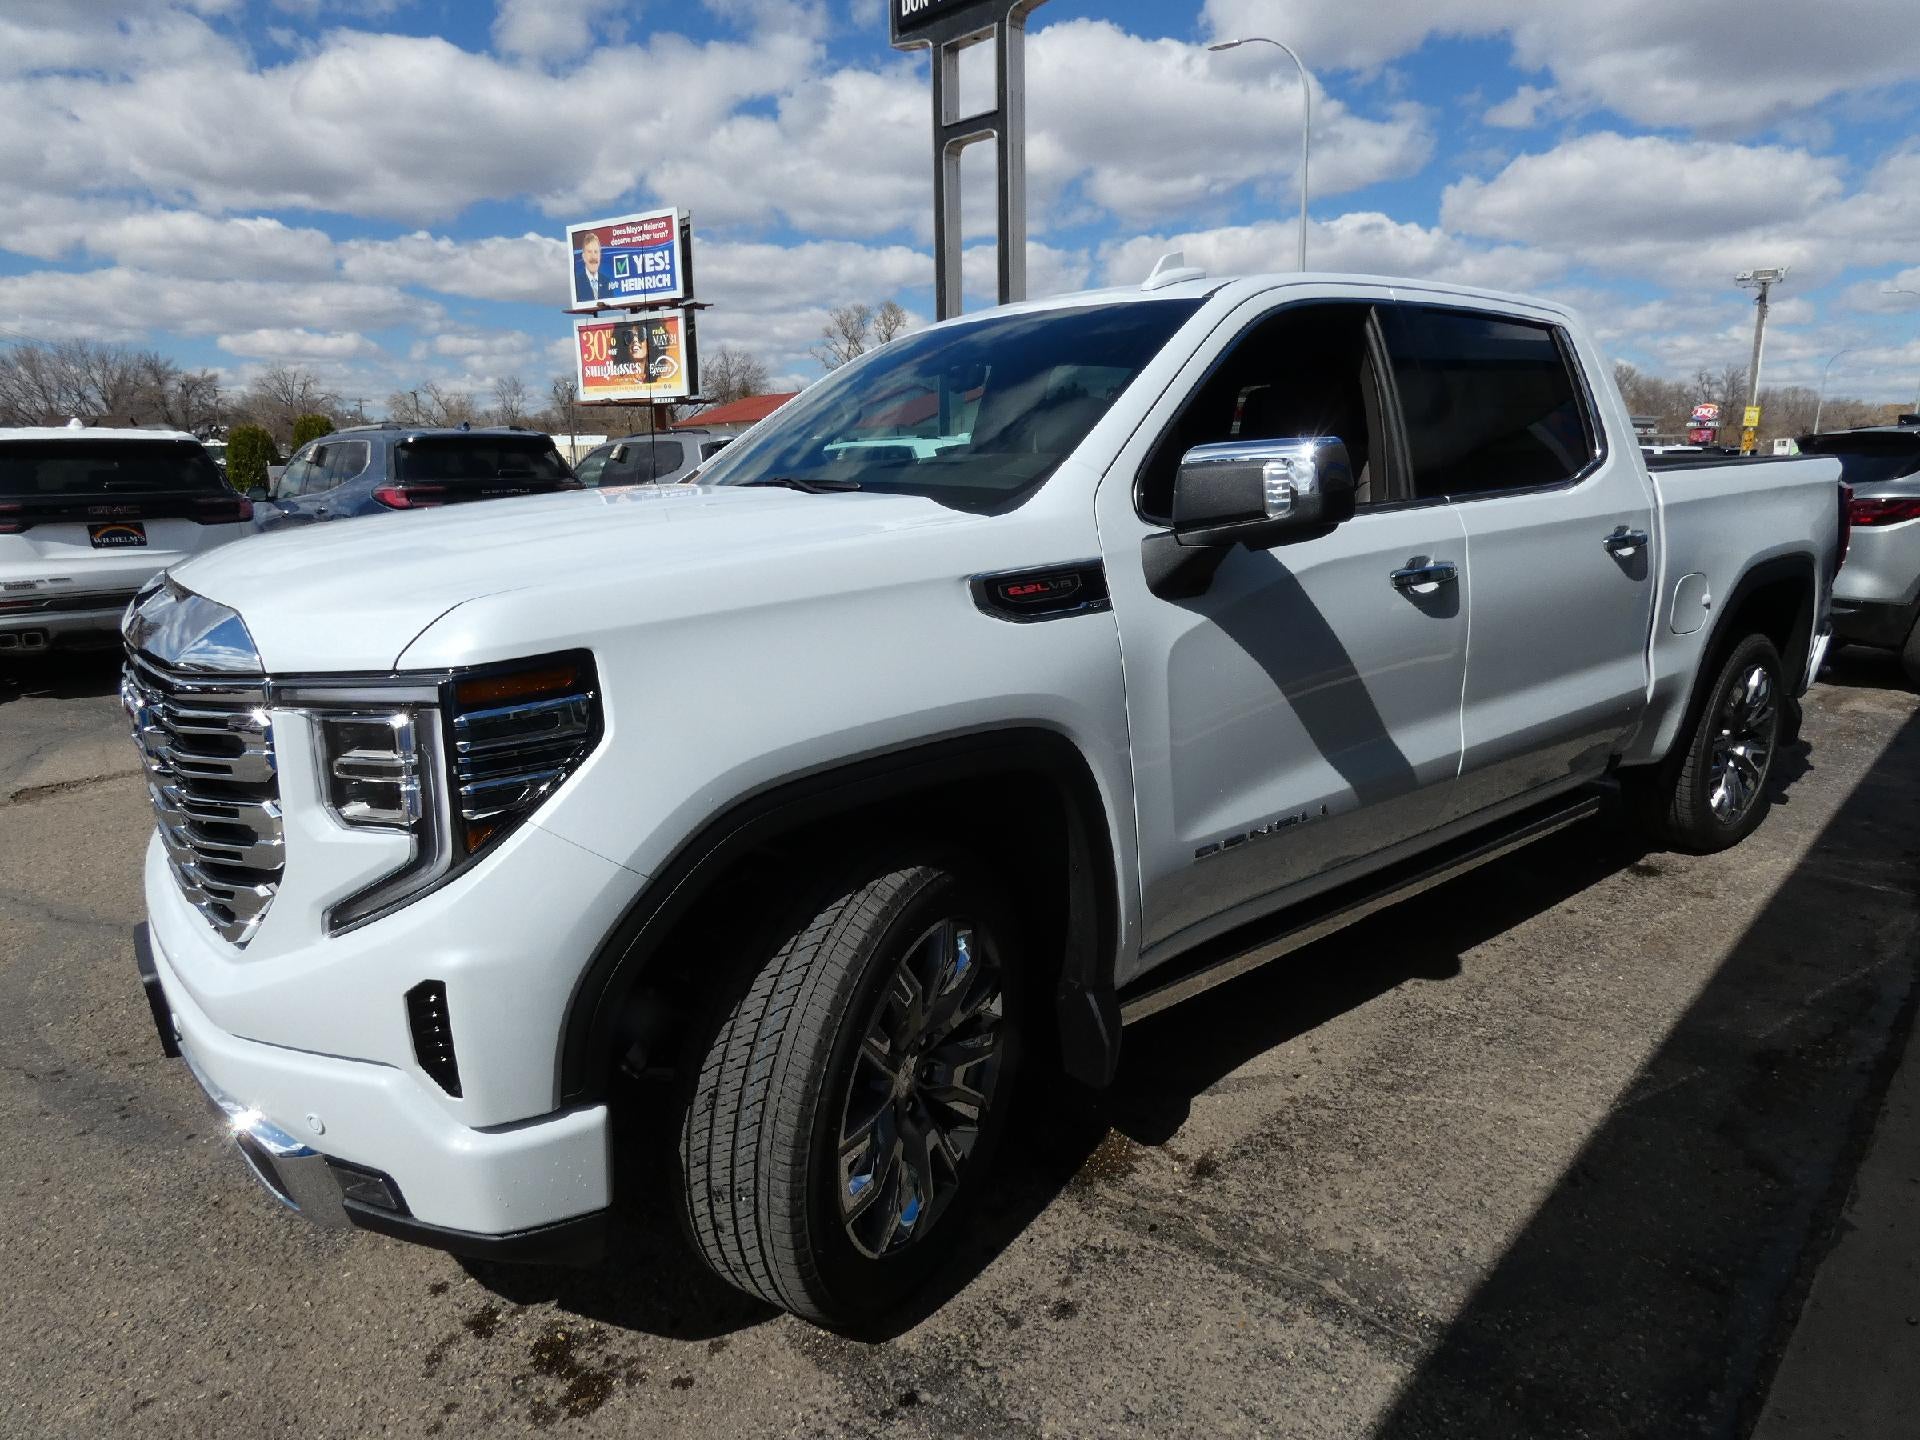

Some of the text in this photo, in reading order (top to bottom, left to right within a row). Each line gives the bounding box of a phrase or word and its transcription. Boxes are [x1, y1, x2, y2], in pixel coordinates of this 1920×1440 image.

[643, 221, 667, 231] Heinrich
[631, 233, 652, 243] another
[633, 250, 670, 274] YES!
[621, 274, 671, 292] HEINRICH
[585, 360, 642, 380] sunglasses
[1697, 407, 1714, 418] DQ
